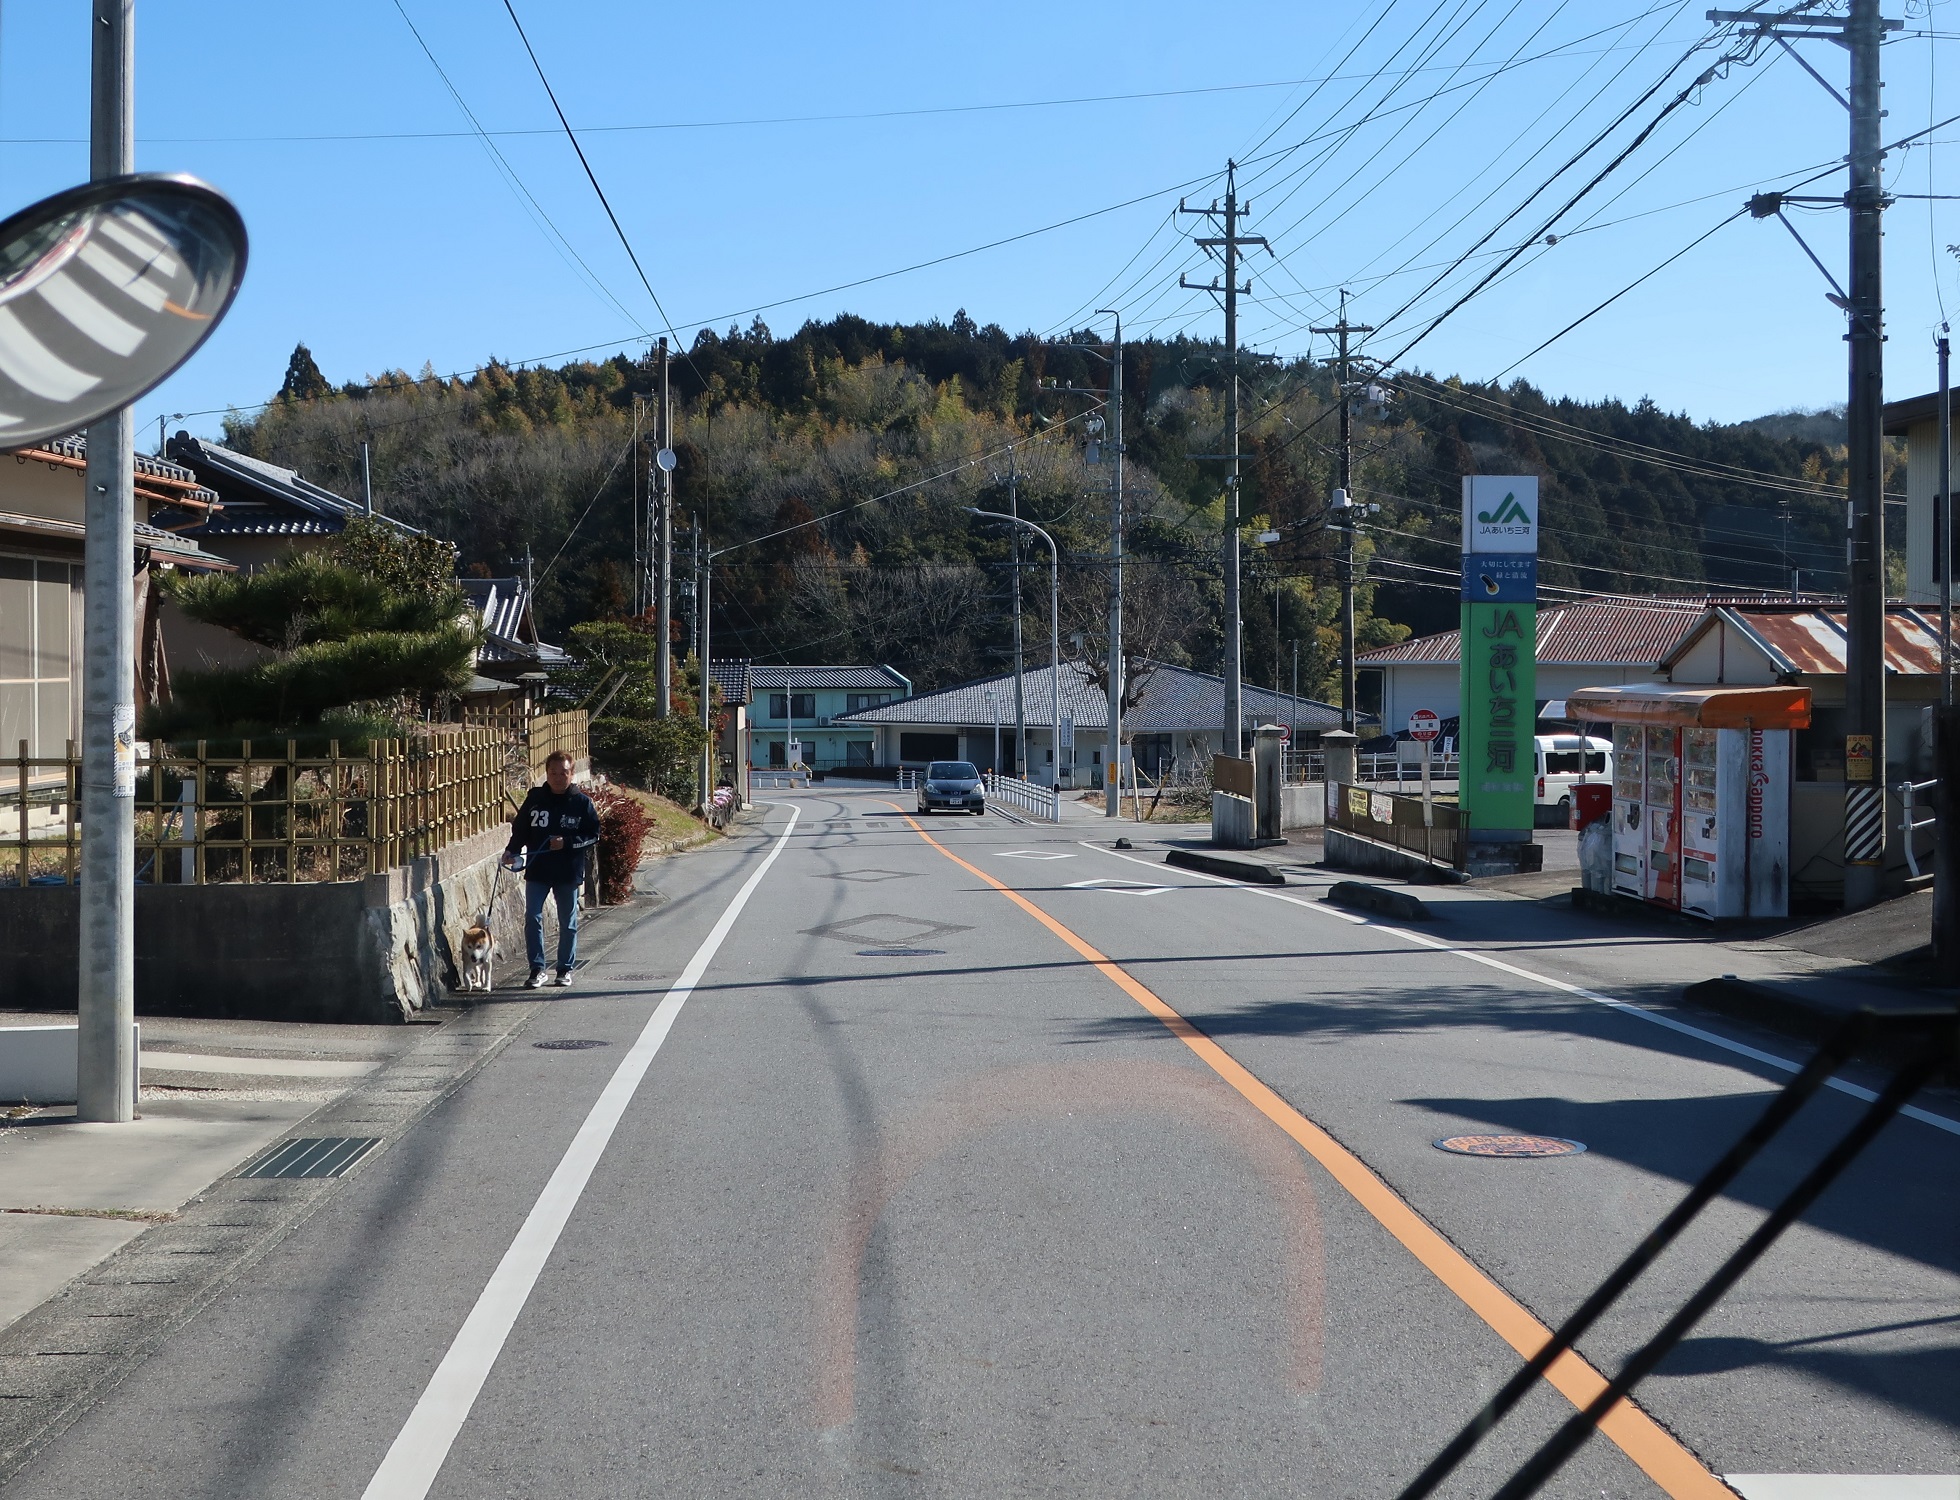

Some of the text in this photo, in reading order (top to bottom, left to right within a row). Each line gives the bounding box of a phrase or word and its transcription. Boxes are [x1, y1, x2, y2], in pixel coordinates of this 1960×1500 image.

[1480, 526, 1531, 535] JAあいち三河
[530, 810, 550, 828] 23
